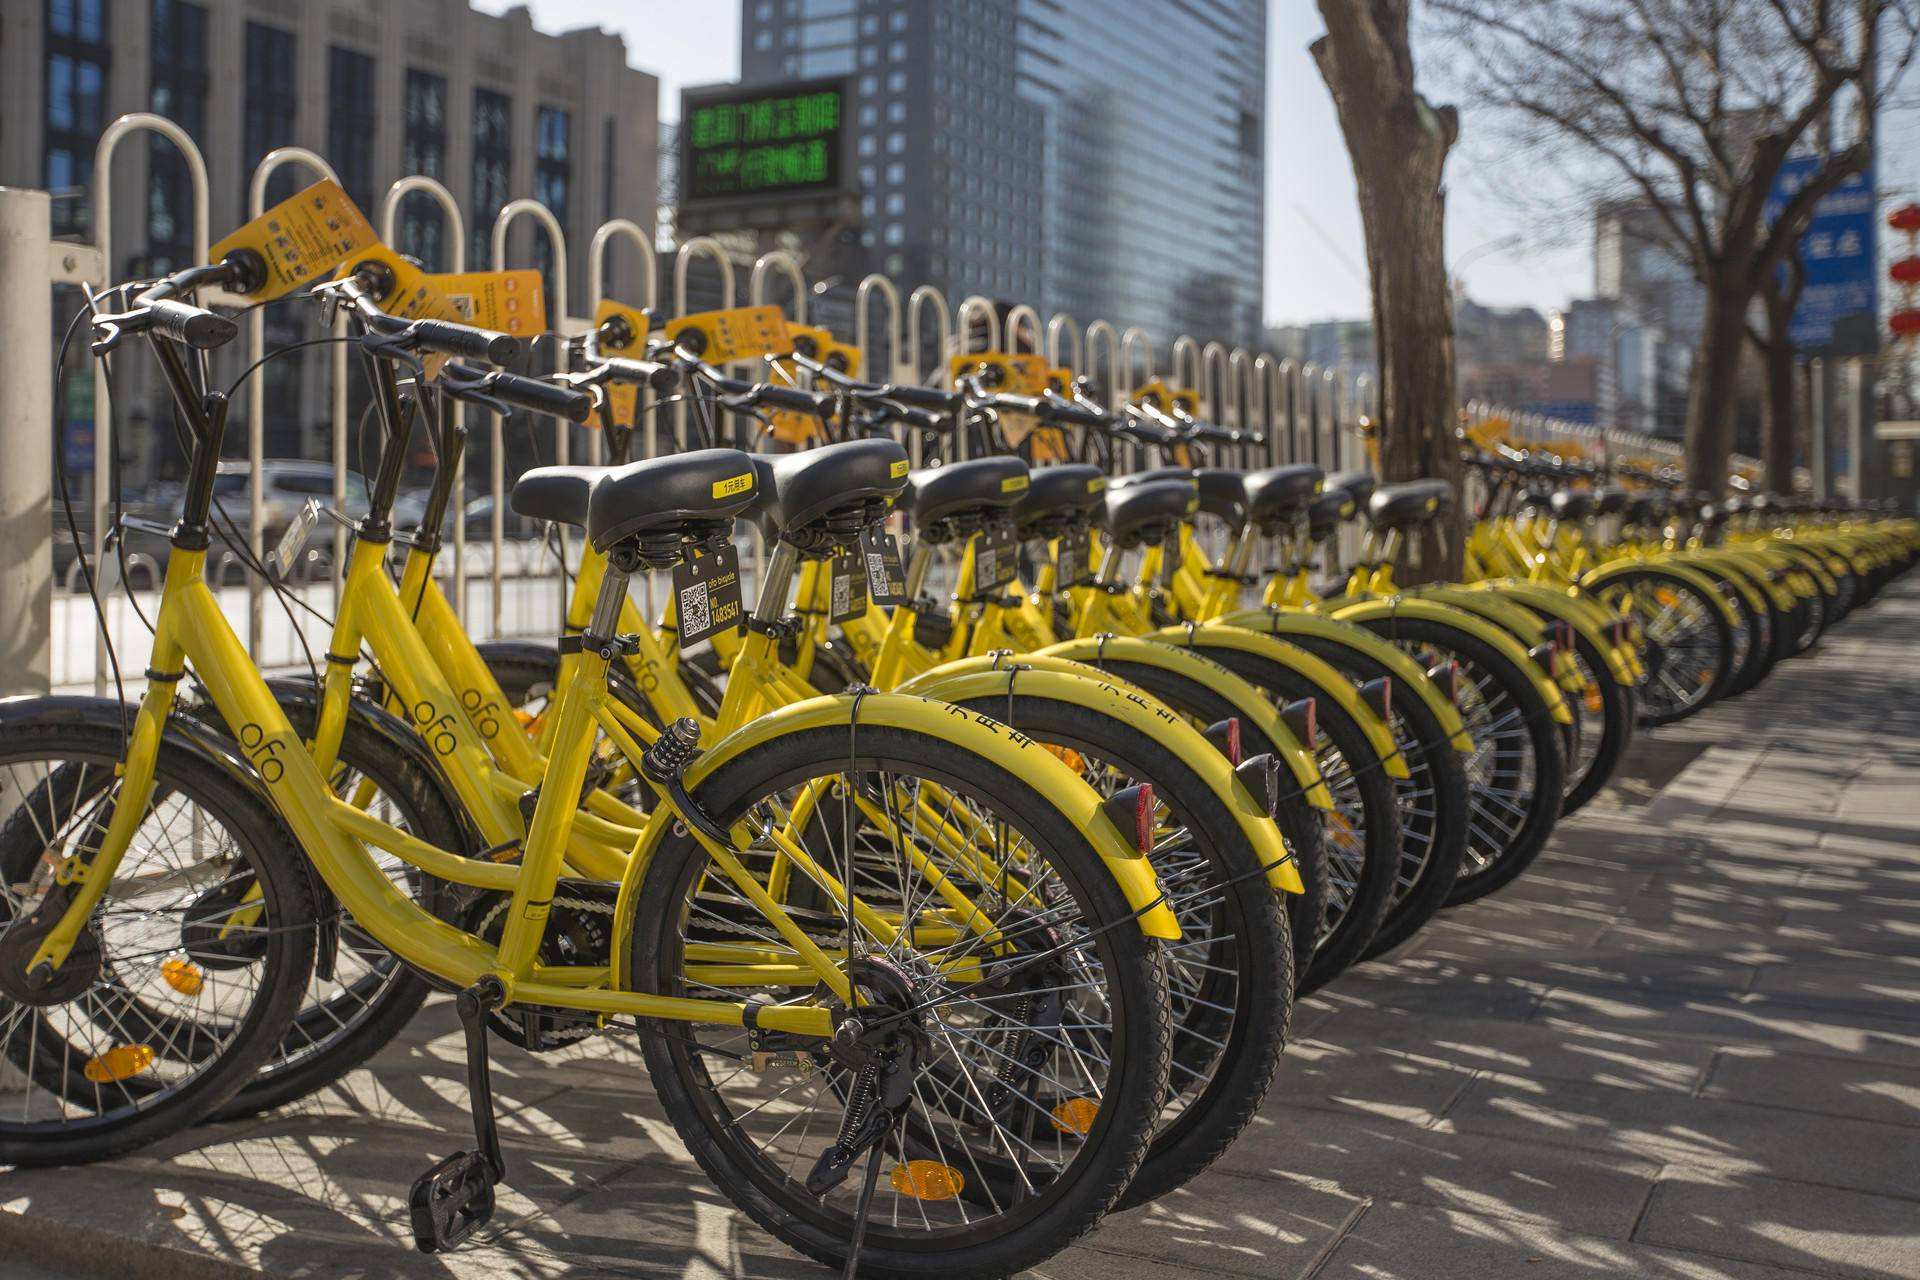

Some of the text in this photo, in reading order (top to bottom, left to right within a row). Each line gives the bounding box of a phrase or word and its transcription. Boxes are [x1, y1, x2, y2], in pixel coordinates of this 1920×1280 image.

[414, 700, 457, 756] ofo
[461, 688, 500, 740] ofo
[922, 697, 1036, 750] 元用车
[240, 722, 286, 784] ofo
